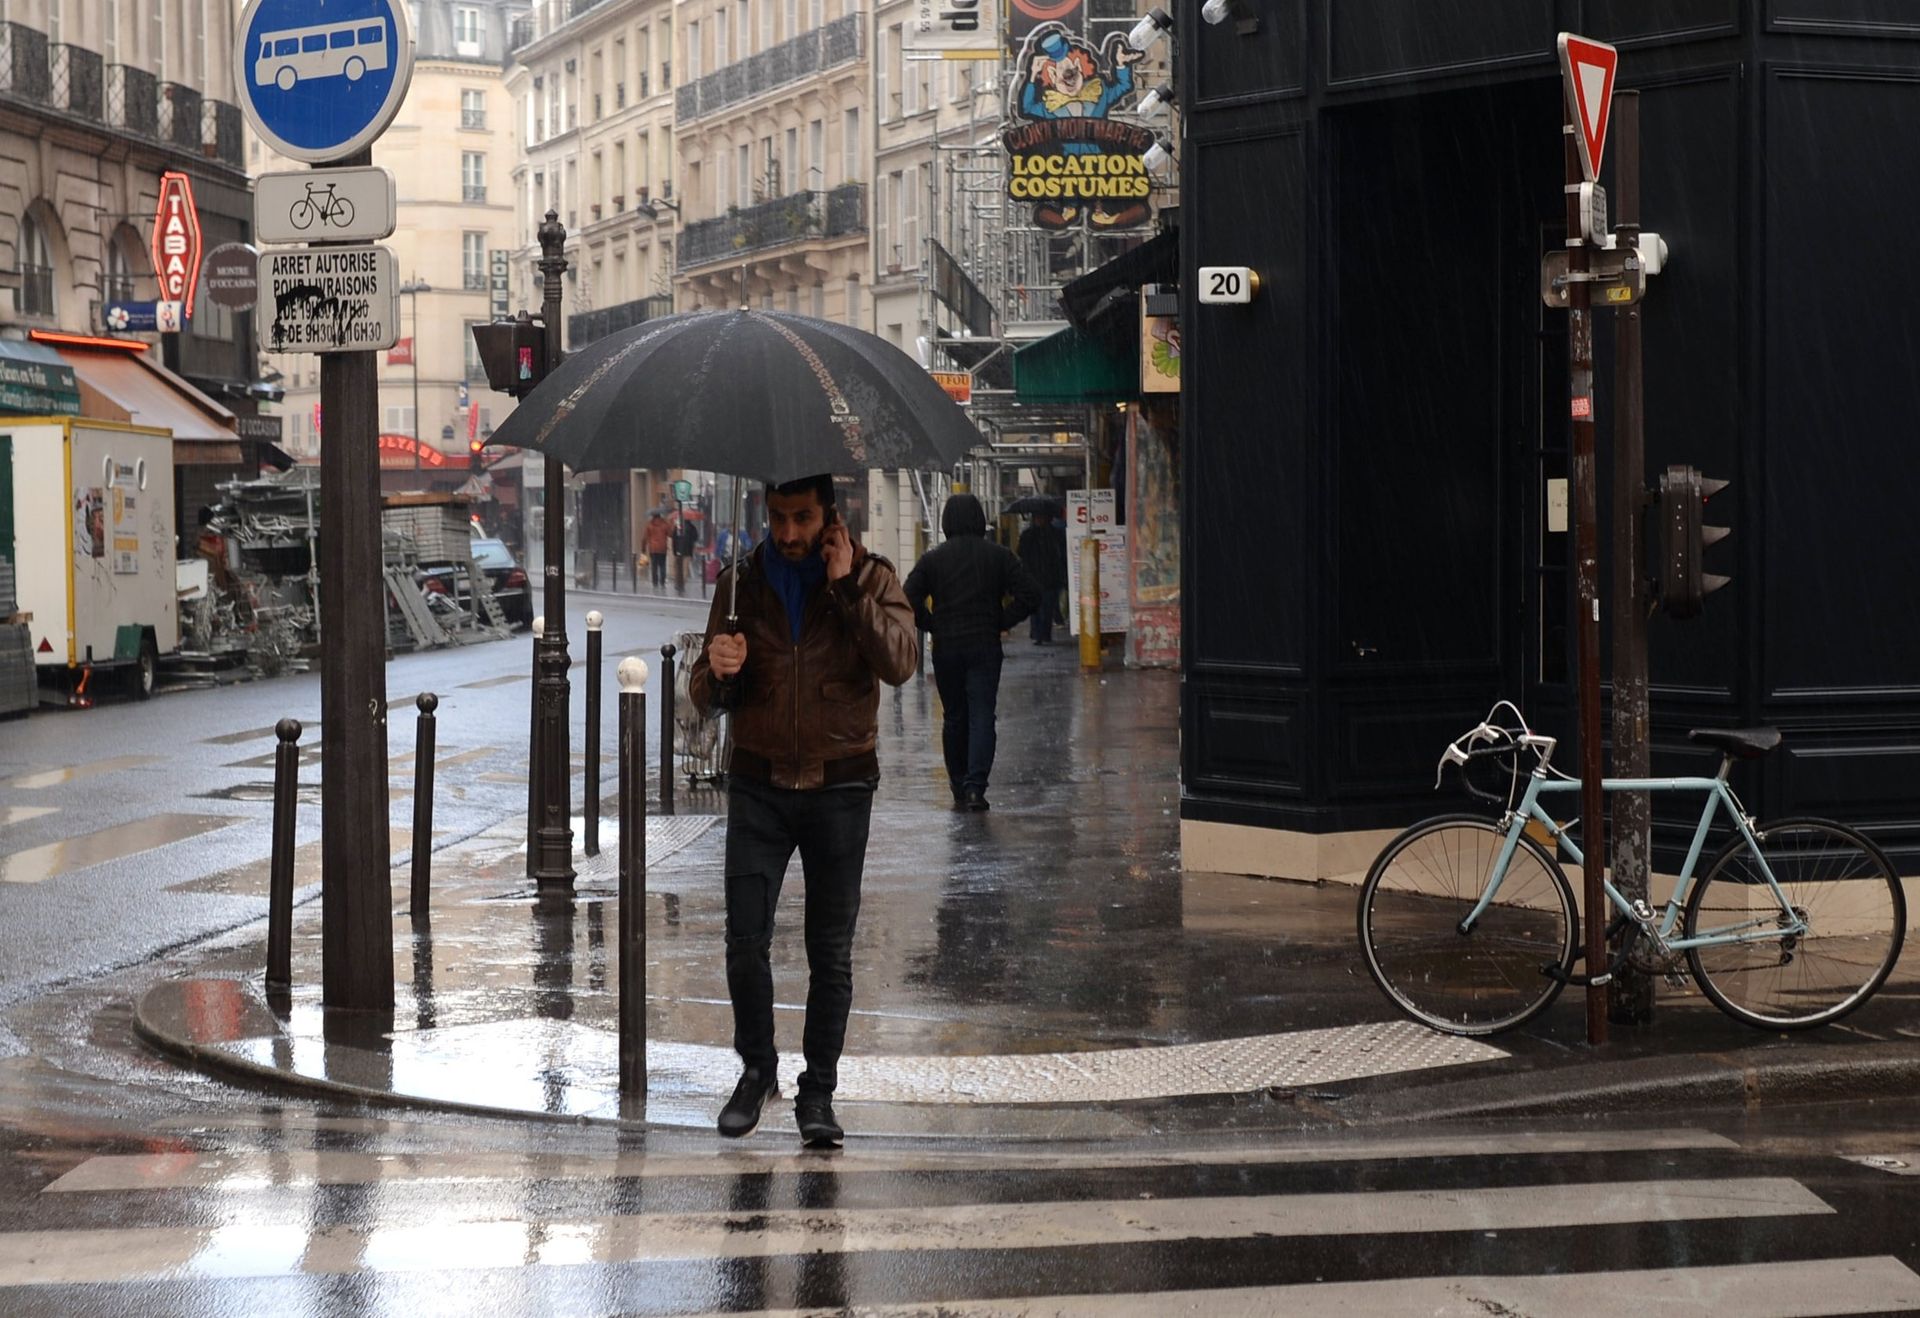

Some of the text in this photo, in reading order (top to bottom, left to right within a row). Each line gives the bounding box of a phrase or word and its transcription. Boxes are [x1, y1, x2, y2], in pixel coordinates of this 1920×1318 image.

[1013, 154, 1145, 176] LOCATION
[1009, 176, 1150, 198] COSTUMES
[164, 194, 187, 295] TABAC
[272, 252, 377, 276] ARRET AUTORISE
[209, 278, 258, 289] D'OCCASION
[491, 250, 508, 316] HOTEL
[1209, 272, 1241, 296] 20
[288, 324, 303, 343] DE
[305, 324, 333, 343] 9H30
[348, 321, 381, 342] 16H30
